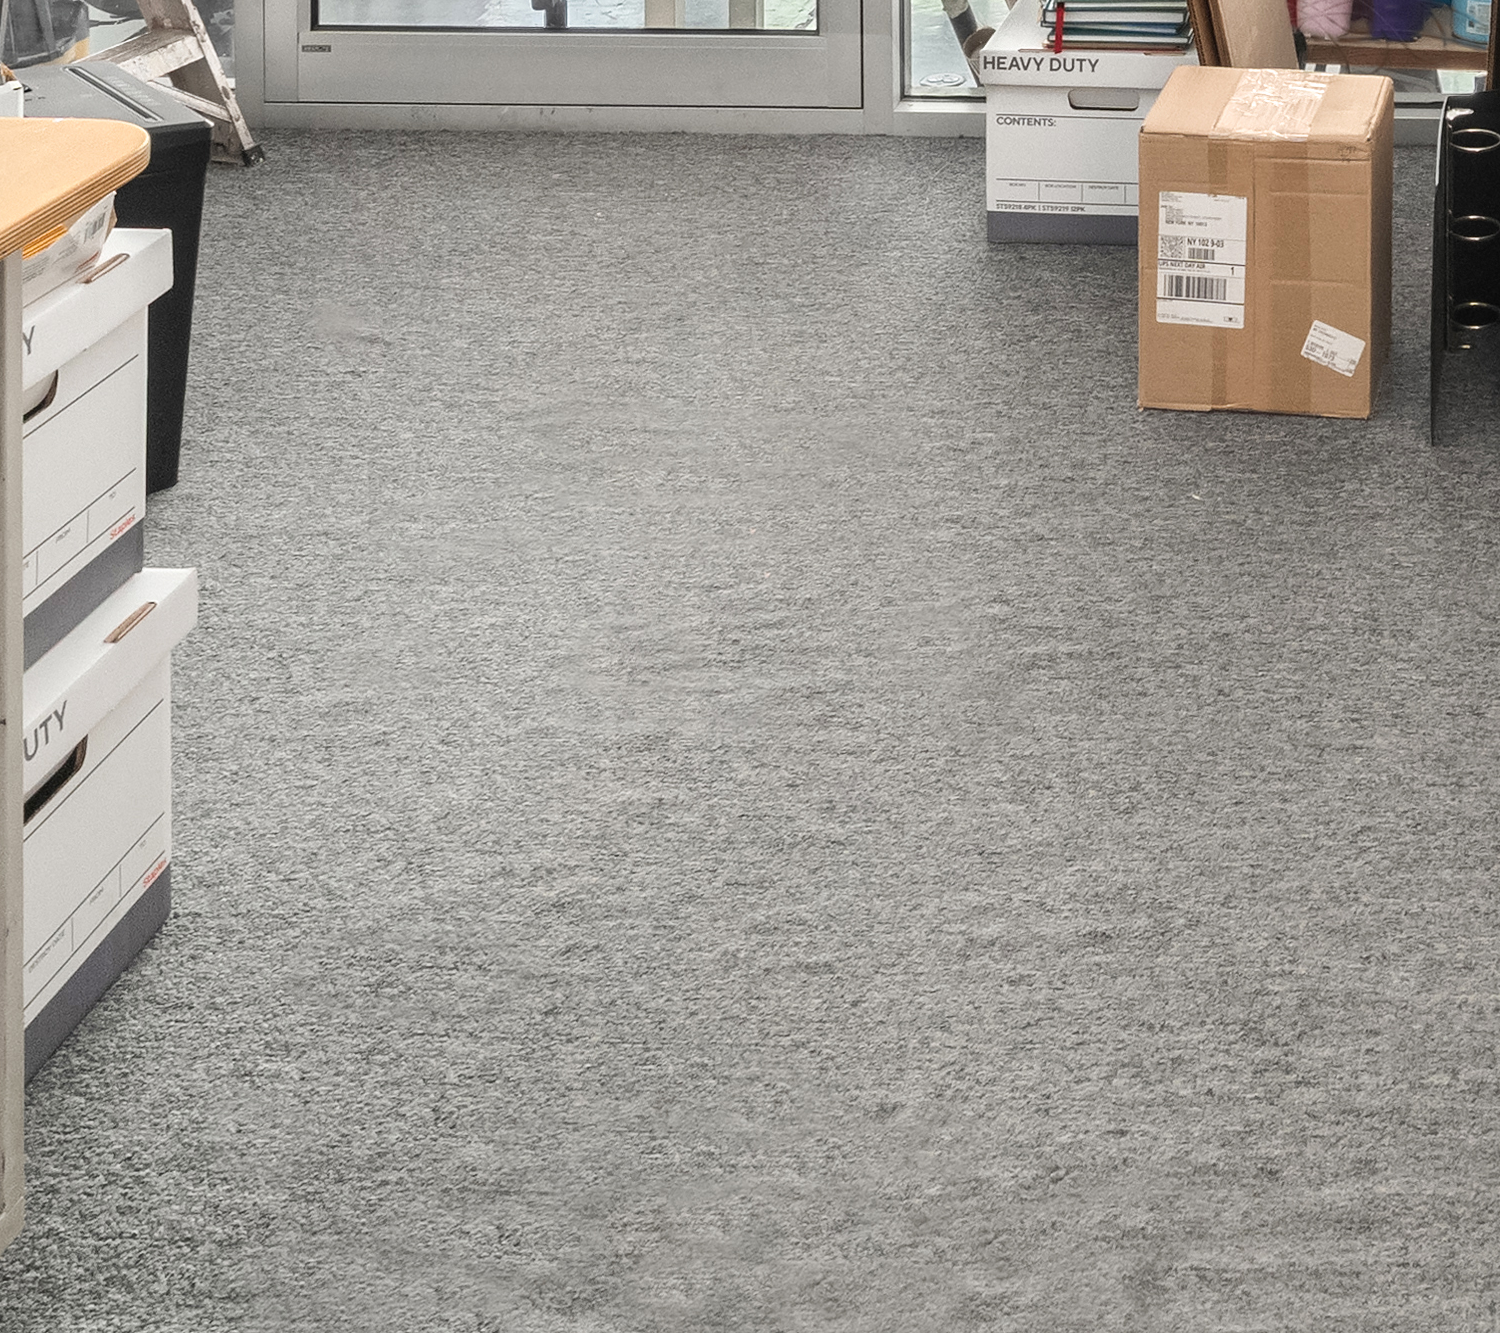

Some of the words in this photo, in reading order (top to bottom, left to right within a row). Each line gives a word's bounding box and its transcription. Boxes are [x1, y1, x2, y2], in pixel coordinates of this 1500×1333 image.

[983, 55, 1044, 73] HEAVY
[1048, 56, 1100, 74] DUTY
[996, 116, 1058, 128] CONTENTS:
[1187, 237, 1197, 247] NY
[1184, 261, 1194, 269] DAY
